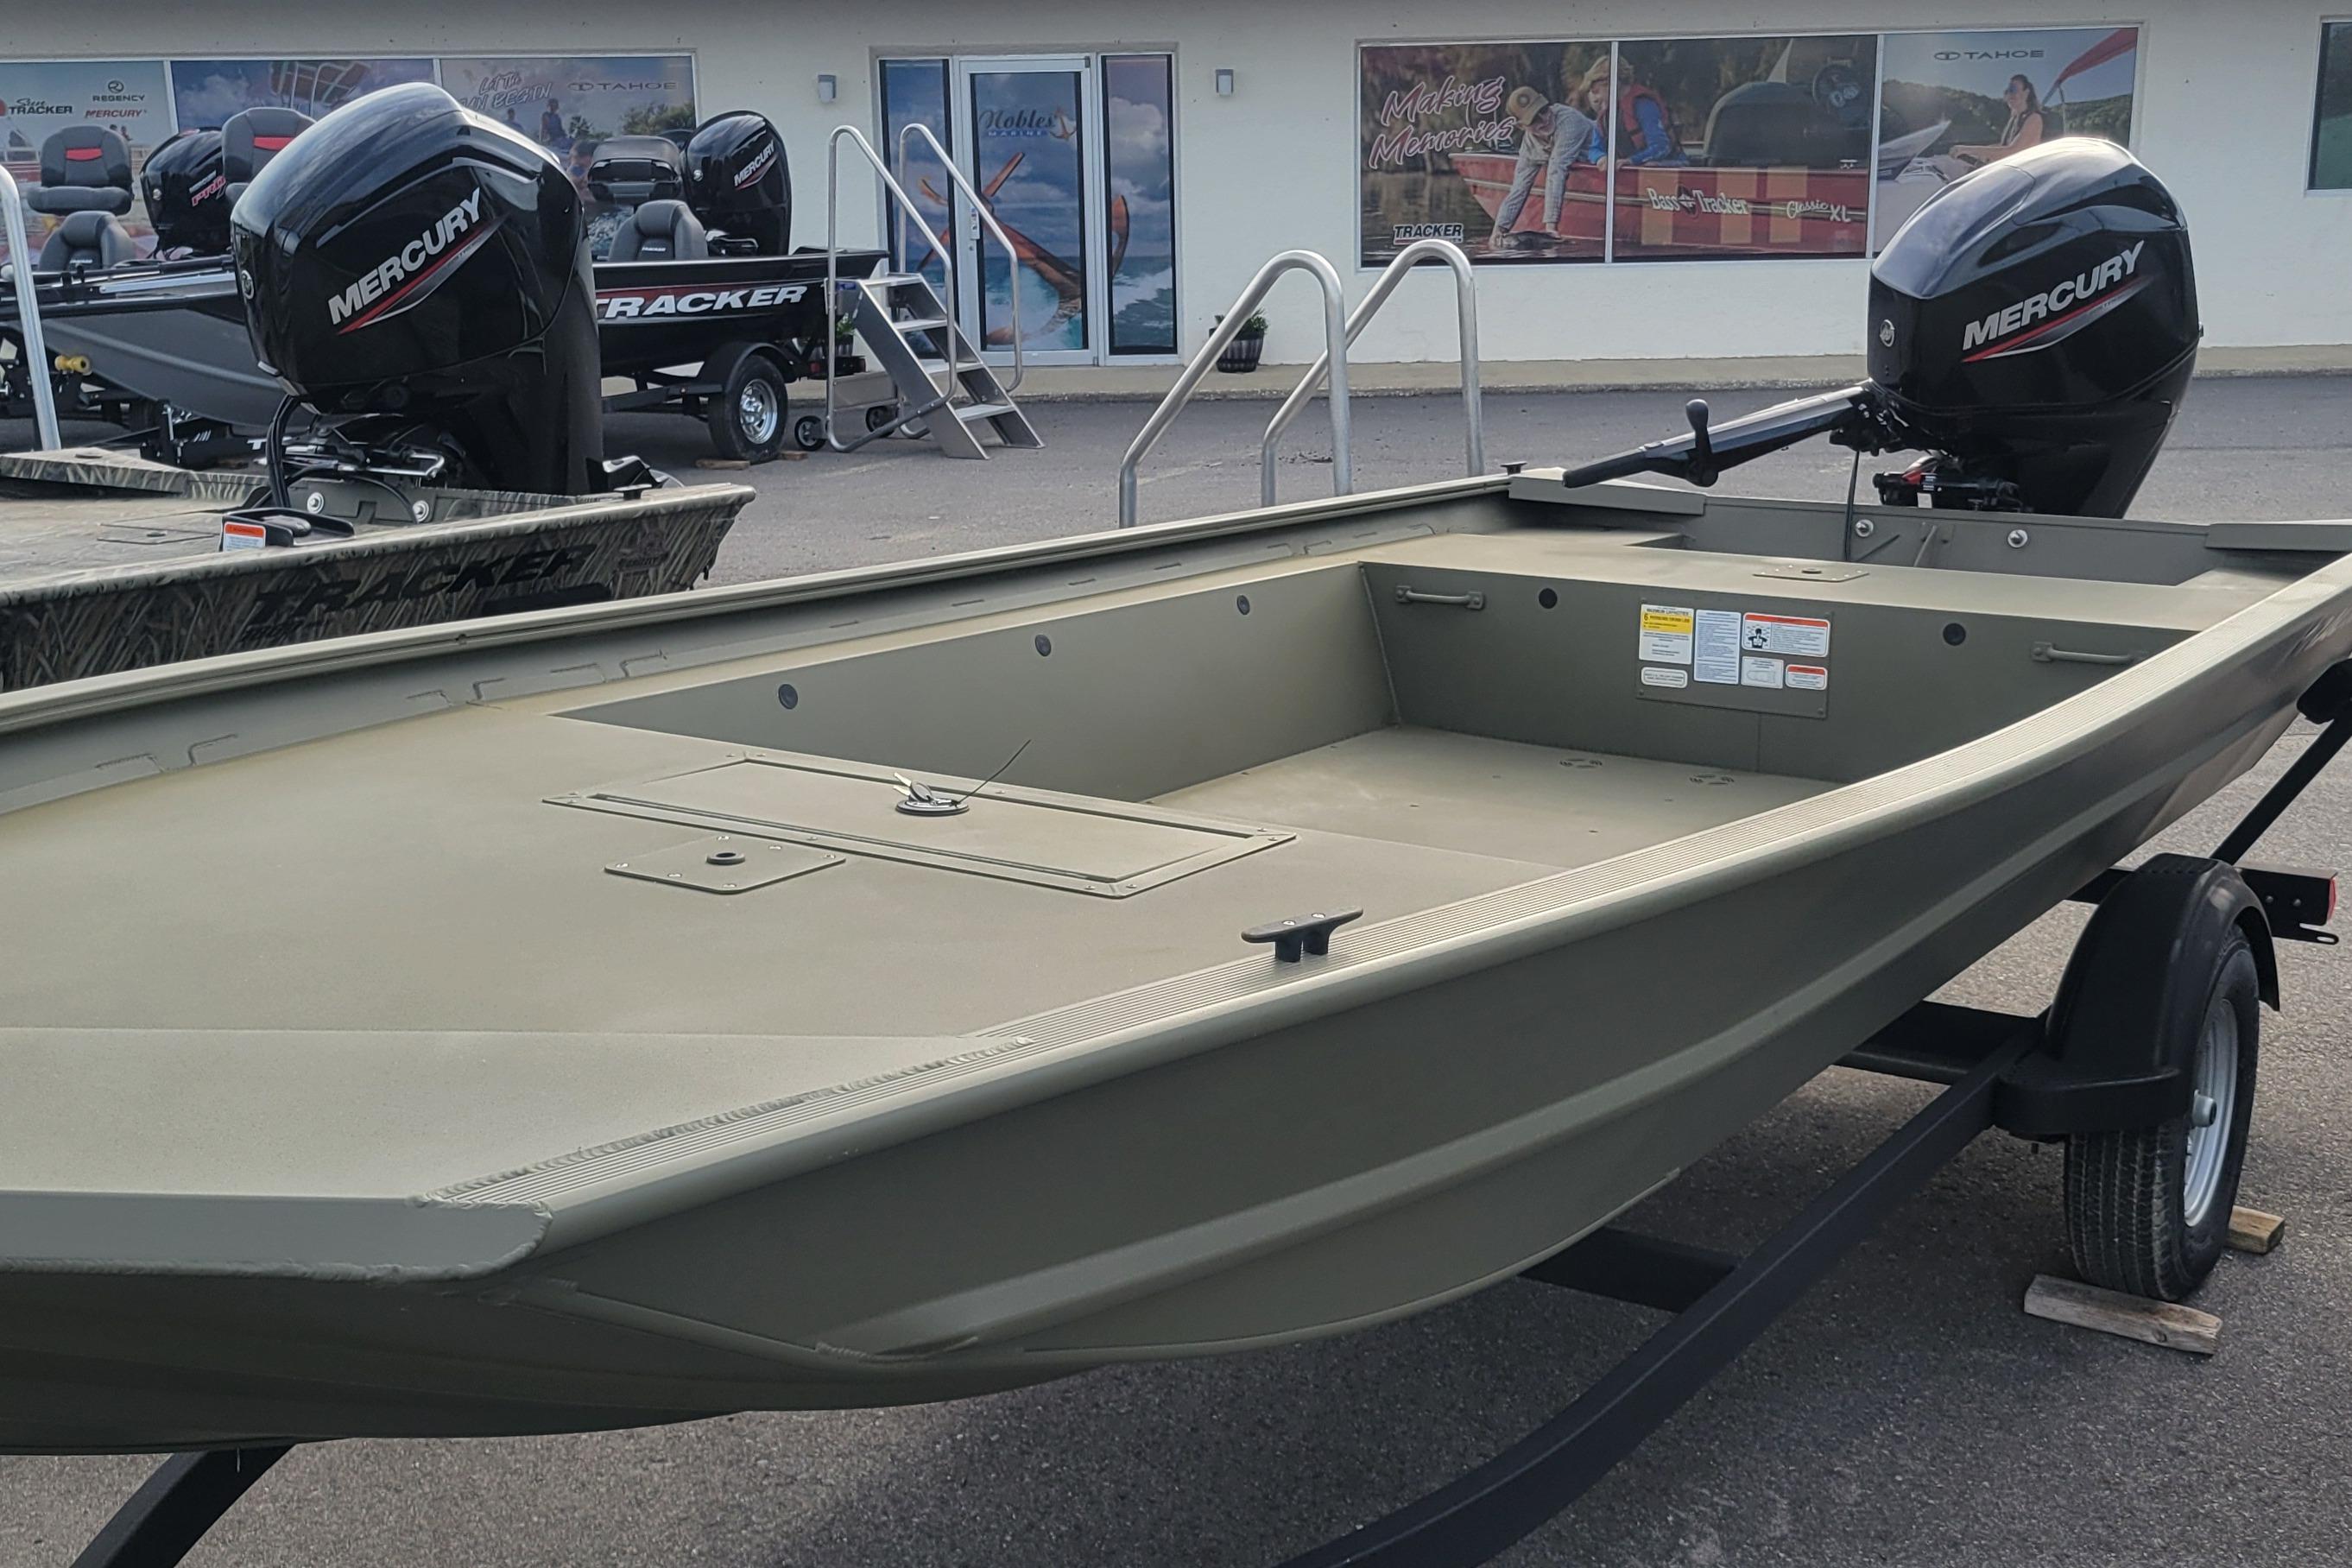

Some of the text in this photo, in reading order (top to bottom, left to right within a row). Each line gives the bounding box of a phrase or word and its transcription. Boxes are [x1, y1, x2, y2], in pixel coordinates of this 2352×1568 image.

[1964, 50, 2045, 60] TAHOE
[492, 82, 553, 109] BEGIN
[597, 81, 679, 91] TAHOE
[9, 105, 73, 115] TRACKER
[16, 98, 46, 106] Sun
[1381, 75, 1506, 127] Making
[85, 109, 142, 119] MERCURY
[979, 110, 1055, 130] Nobles
[1369, 116, 1516, 169] Memories
[733, 139, 775, 187] MERCURY
[1647, 187, 1852, 223] Bass Tracker Classic XL
[1394, 224, 1463, 239] TRACKER
[328, 187, 480, 326] MERCURY
[1963, 240, 2145, 351] MERCURY
